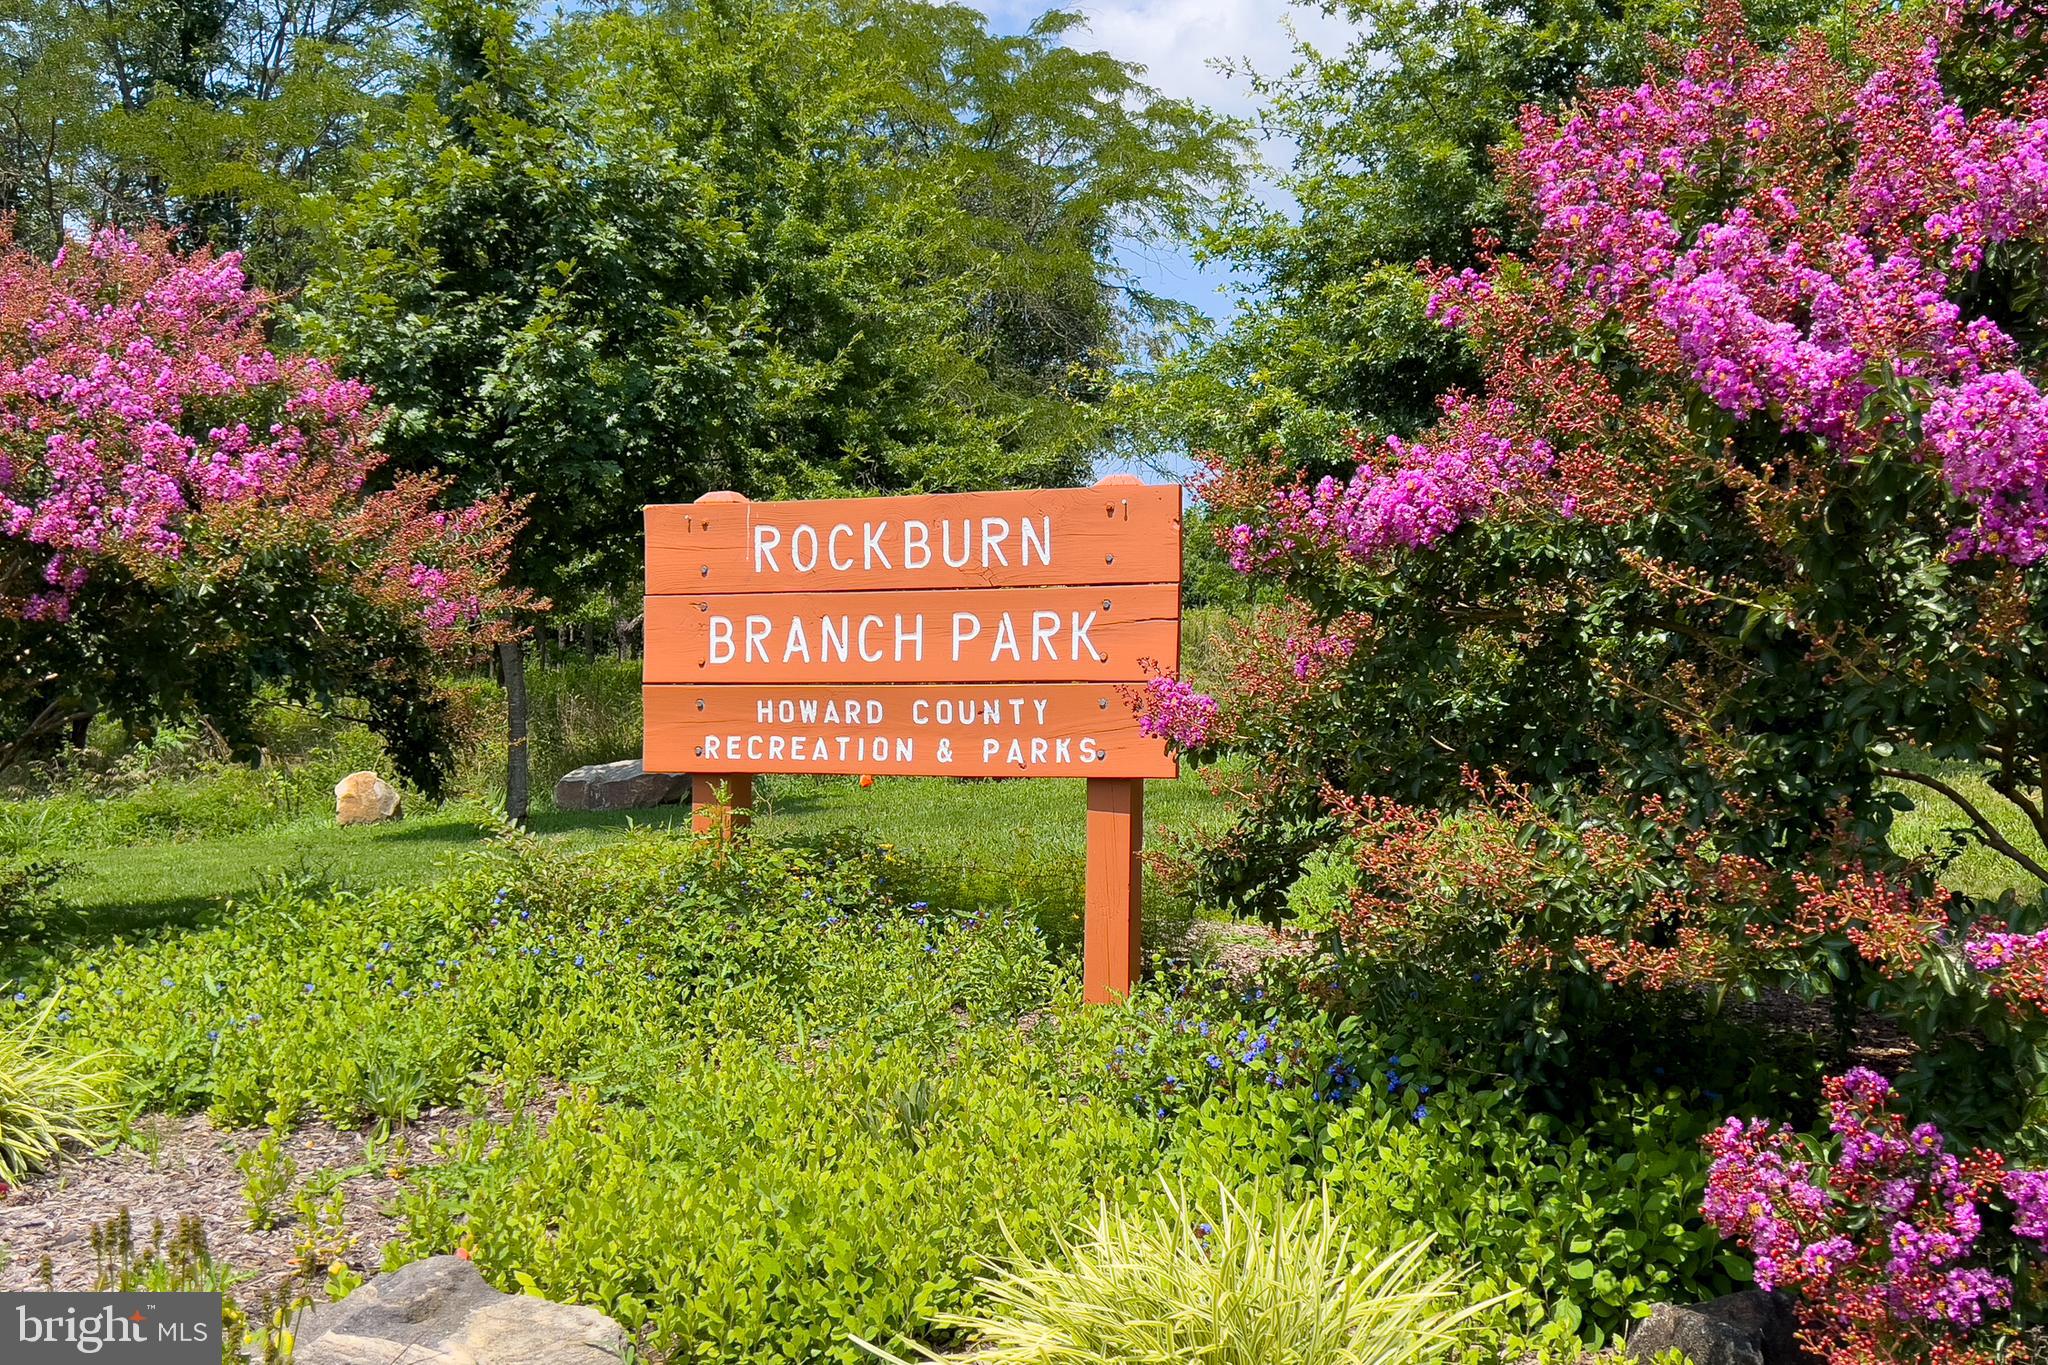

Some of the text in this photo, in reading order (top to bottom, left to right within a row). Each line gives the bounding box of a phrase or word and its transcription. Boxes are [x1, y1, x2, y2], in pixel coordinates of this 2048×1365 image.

[754, 516, 1051, 573] ROCKBURN
[709, 609, 1102, 665] BRANCH PARK
[756, 698, 1049, 726] HOWARD COUNTY
[704, 735, 1098, 764] RECREATION & PARKS
